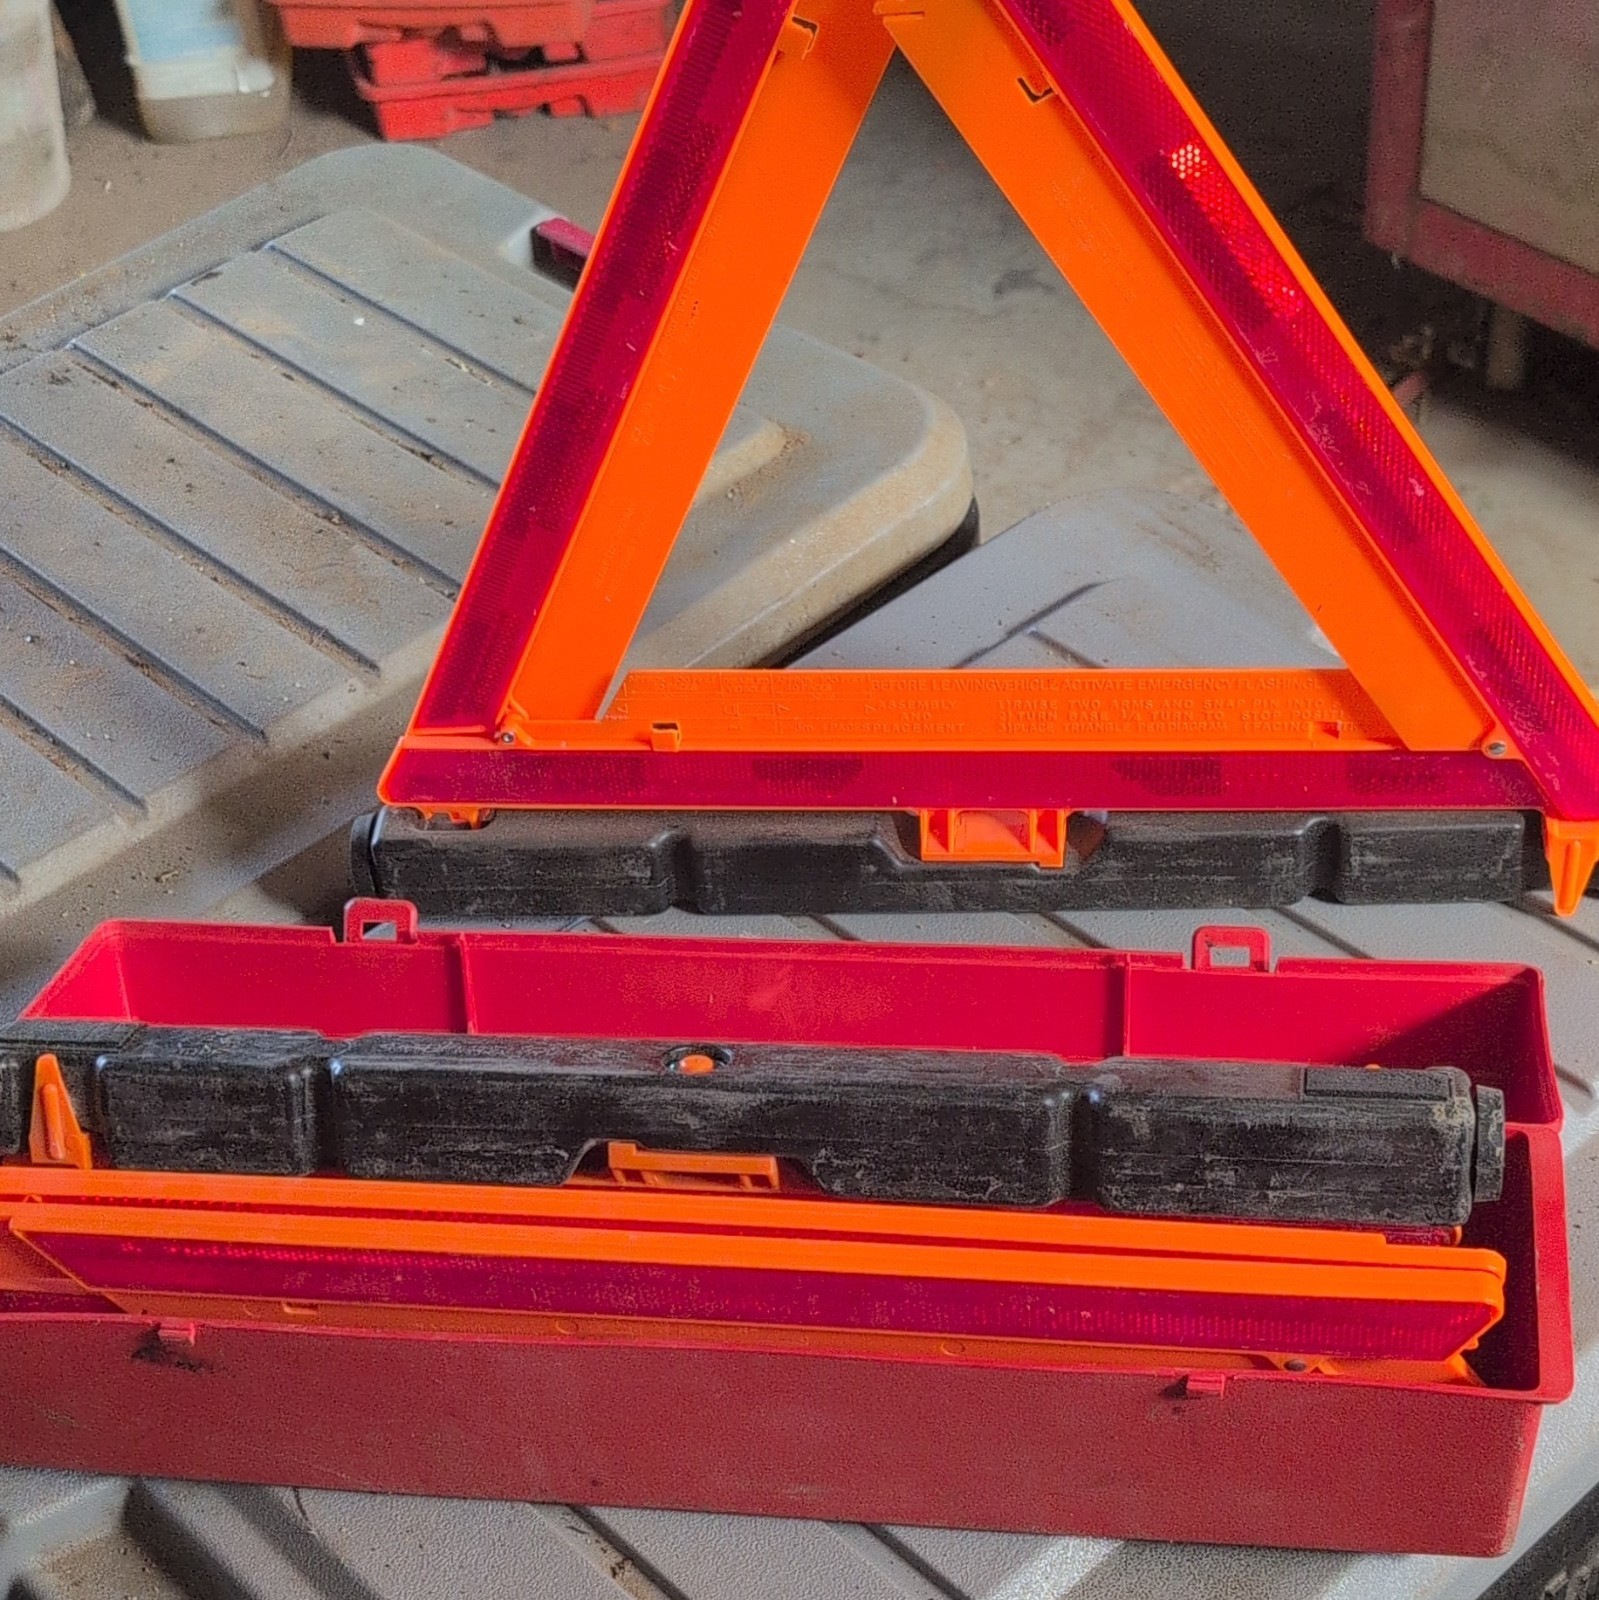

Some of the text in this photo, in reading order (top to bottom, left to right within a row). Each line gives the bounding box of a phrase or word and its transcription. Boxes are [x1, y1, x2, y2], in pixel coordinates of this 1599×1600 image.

[871, 678, 929, 692] BEFORE
[1063, 678, 1134, 691] ACTIVATE
[1137, 678, 1237, 691] EMERGENCY
[878, 699, 958, 711] ASSEMBLY
[1067, 699, 1102, 710] TWO
[1110, 699, 1154, 710] ARMS
[1162, 699, 1194, 710] AND
[1202, 699, 1246, 709] SNAP
[1253, 699, 1280, 709] PIN
[1287, 699, 1325, 709] INTO
[898, 711, 932, 722] AND
[1068, 711, 1110, 722] BASE
[1151, 711, 1194, 722] TURN
[1203, 711, 1225, 721] TO
[1240, 711, 1282, 721] STOP
[873, 722, 966, 734] PLACEMENT
[1062, 722, 1131, 733] TRIANGLE
[1168, 721, 1228, 733] DIAGRAM
